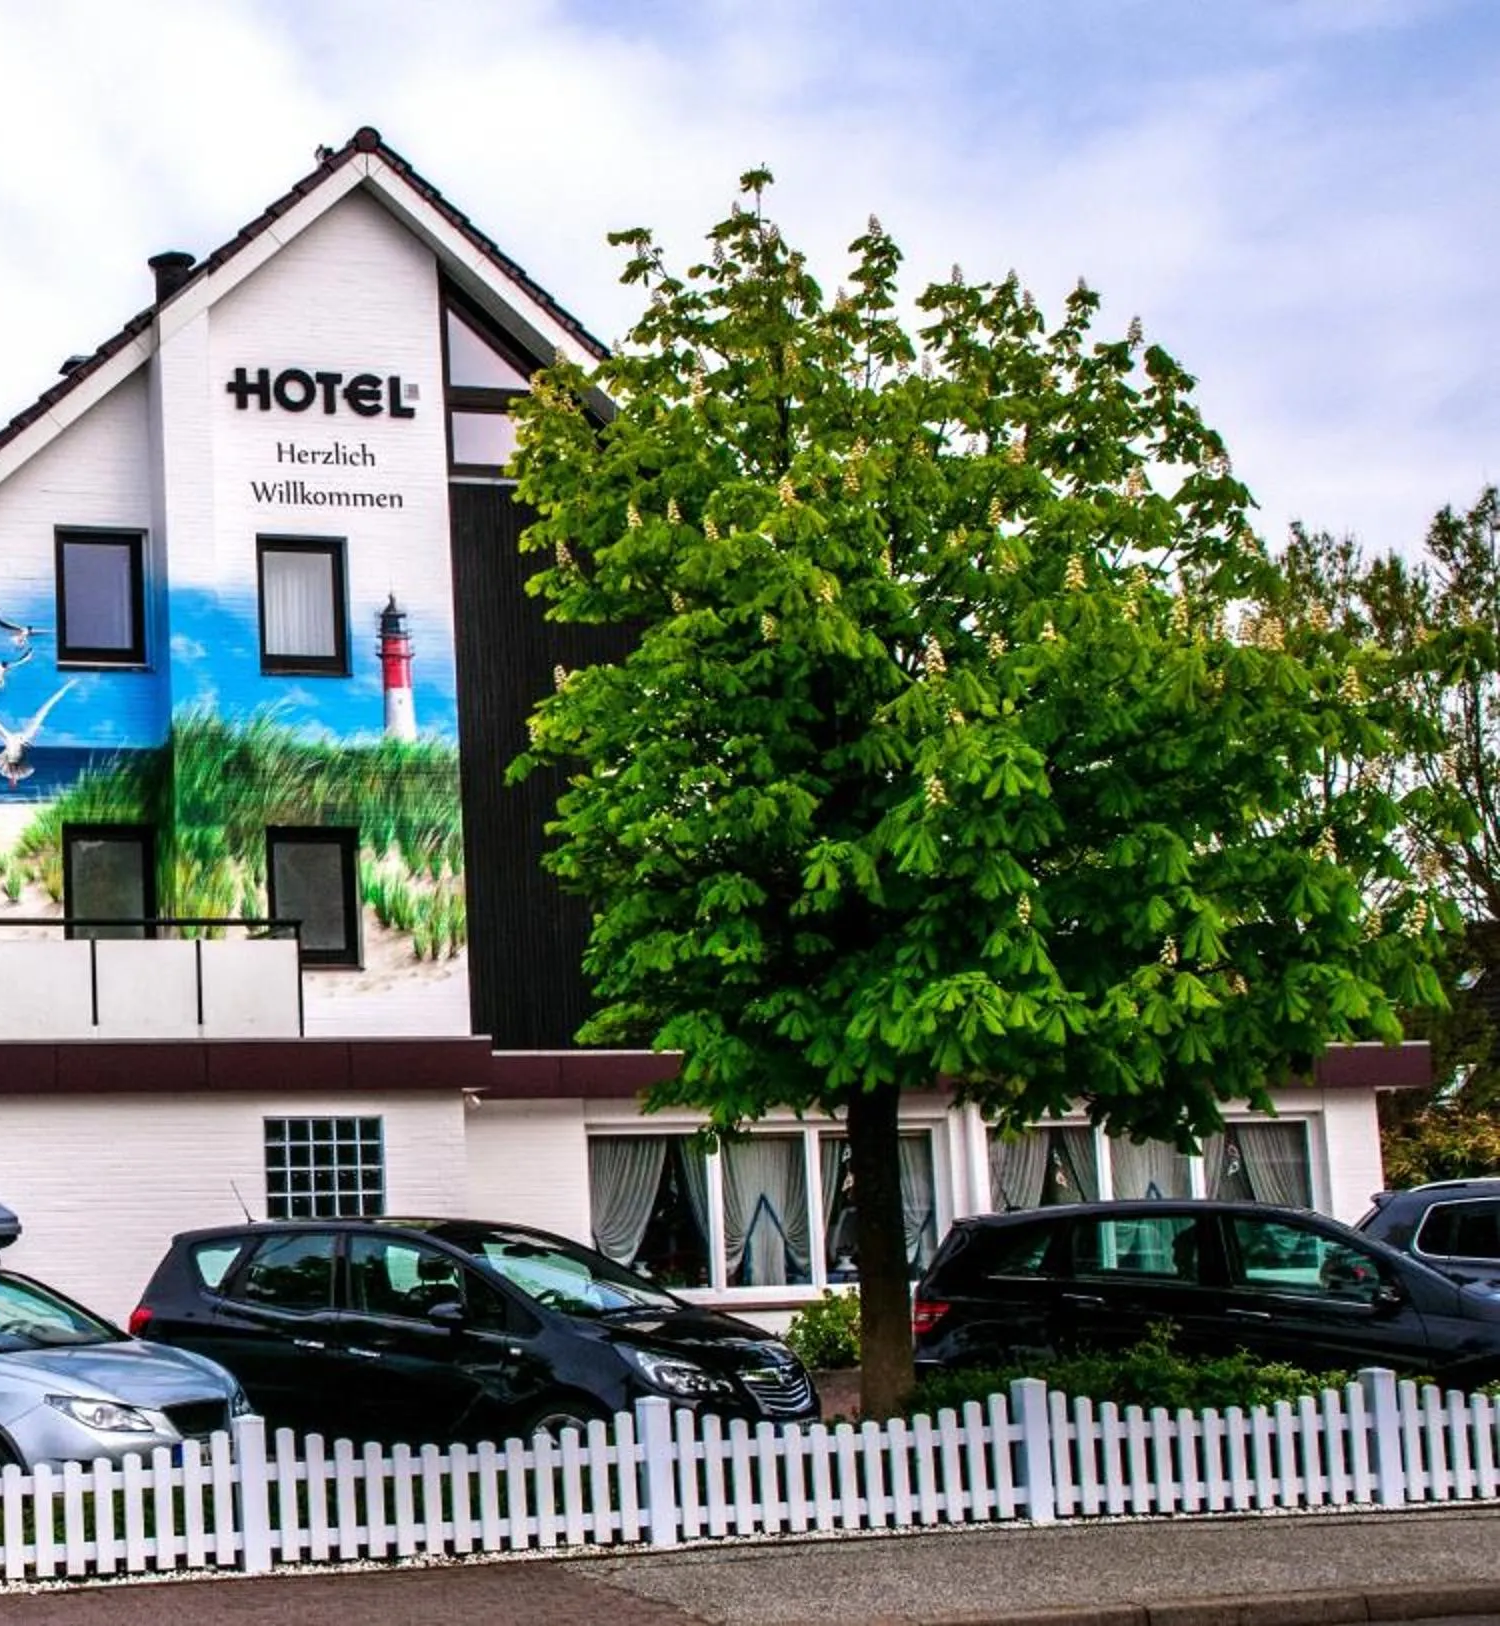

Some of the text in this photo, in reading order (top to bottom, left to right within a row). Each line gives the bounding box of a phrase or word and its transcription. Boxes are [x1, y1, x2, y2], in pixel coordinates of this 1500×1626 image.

[226, 367, 415, 419] HOTEL
[276, 441, 376, 467] Herzlich
[251, 480, 404, 509] Willkommen
